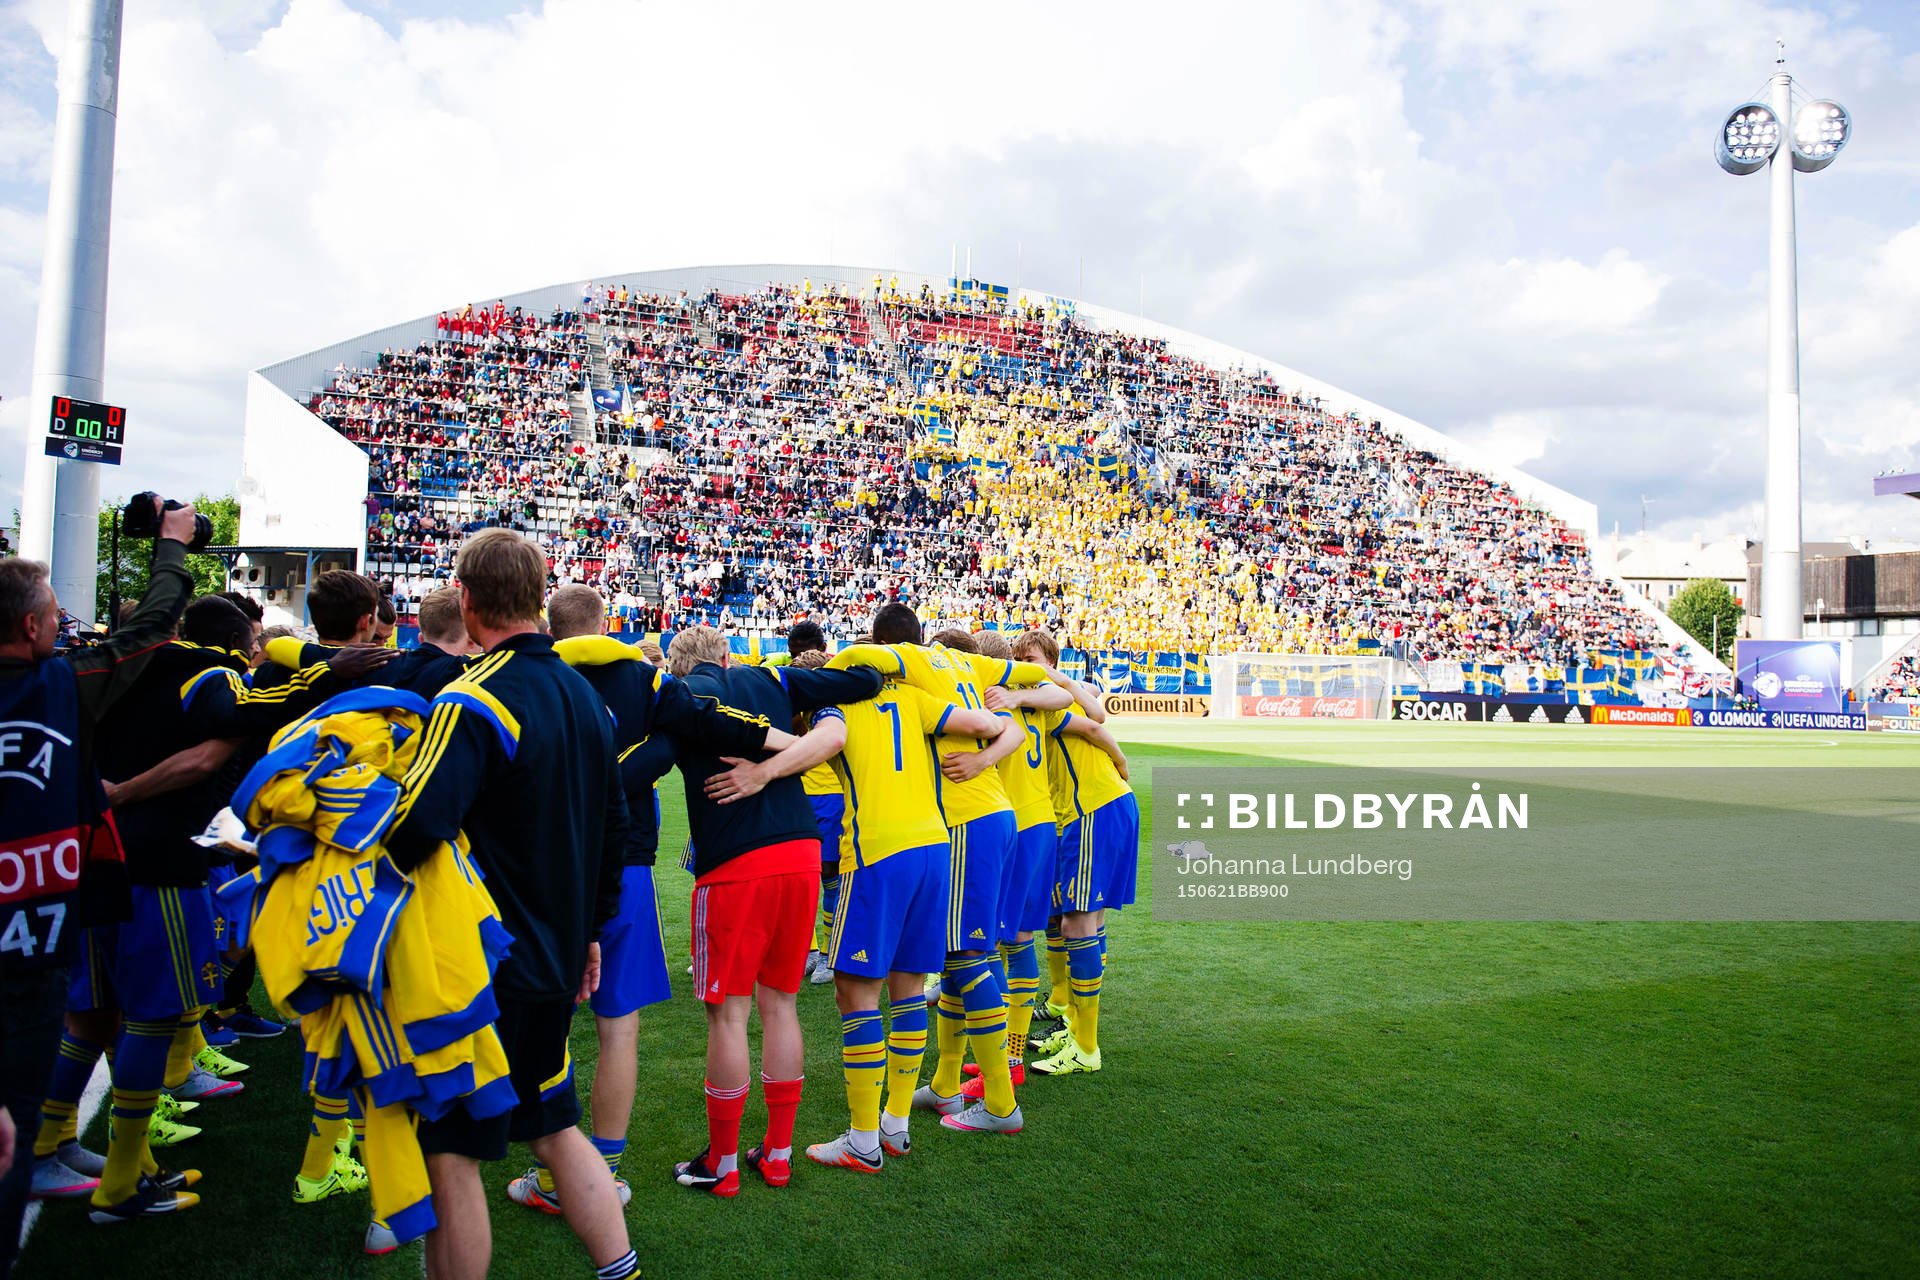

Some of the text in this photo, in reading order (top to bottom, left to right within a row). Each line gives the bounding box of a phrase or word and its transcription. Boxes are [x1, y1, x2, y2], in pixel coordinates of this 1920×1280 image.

[57, 398, 70, 418] 0
[108, 407, 121, 426] 0
[54, 418, 66, 431] D
[76, 418, 102, 440] 00
[106, 426, 117, 440] H
[1104, 695, 1194, 715] Continental
[1400, 701, 1467, 721] SOCAR
[1609, 709, 1675, 723] McDonald's
[1708, 711, 1767, 728] OLOMOUC
[1784, 712, 1815, 728] UEFA
[1815, 714, 1851, 730] UNDER
[1852, 717, 1865, 730] 21
[1882, 717, 1920, 731] FOUN
[874, 702, 902, 772] 7
[0, 903, 67, 957] 47
